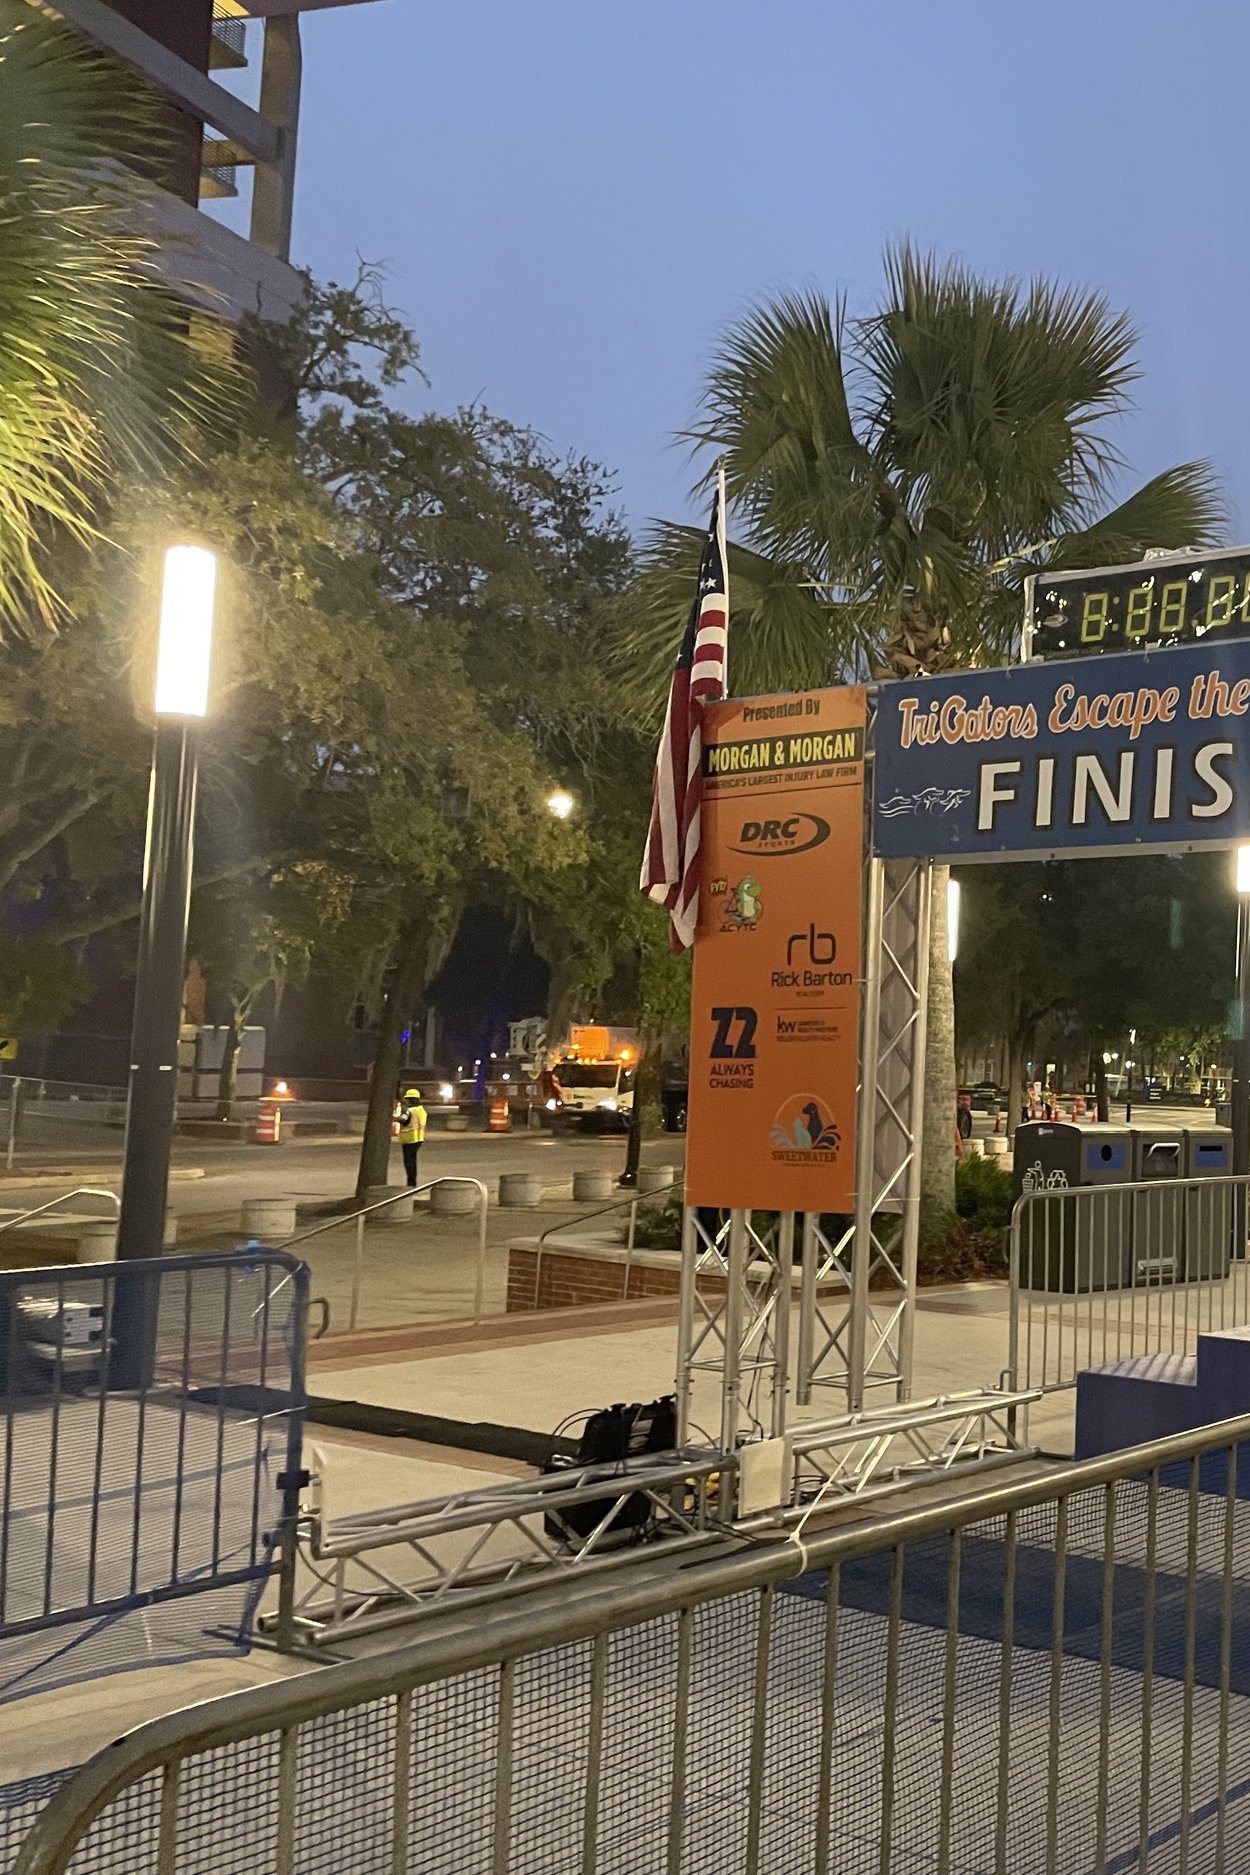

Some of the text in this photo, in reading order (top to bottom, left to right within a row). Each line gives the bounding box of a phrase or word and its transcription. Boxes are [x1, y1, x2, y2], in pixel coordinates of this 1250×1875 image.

[742, 697, 821, 723] Presented By
[897, 694, 1038, 749] TriGators
[1047, 683, 1181, 740] Escape
[708, 731, 856, 774] MORGAN & MORGAN
[705, 766, 858, 790] AMERICA'S LARGEST INJURY LAW FIRM
[740, 817, 802, 843] DRC
[757, 839, 796, 848] SPORTS
[787, 922, 837, 966] rb
[771, 970, 853, 988] Rick Barton
[777, 1016, 796, 1034] kw
[709, 1064, 754, 1076] ALWAYS
[709, 1078, 754, 1089] CHASING
[771, 1150, 837, 1163] SWEETWATER
